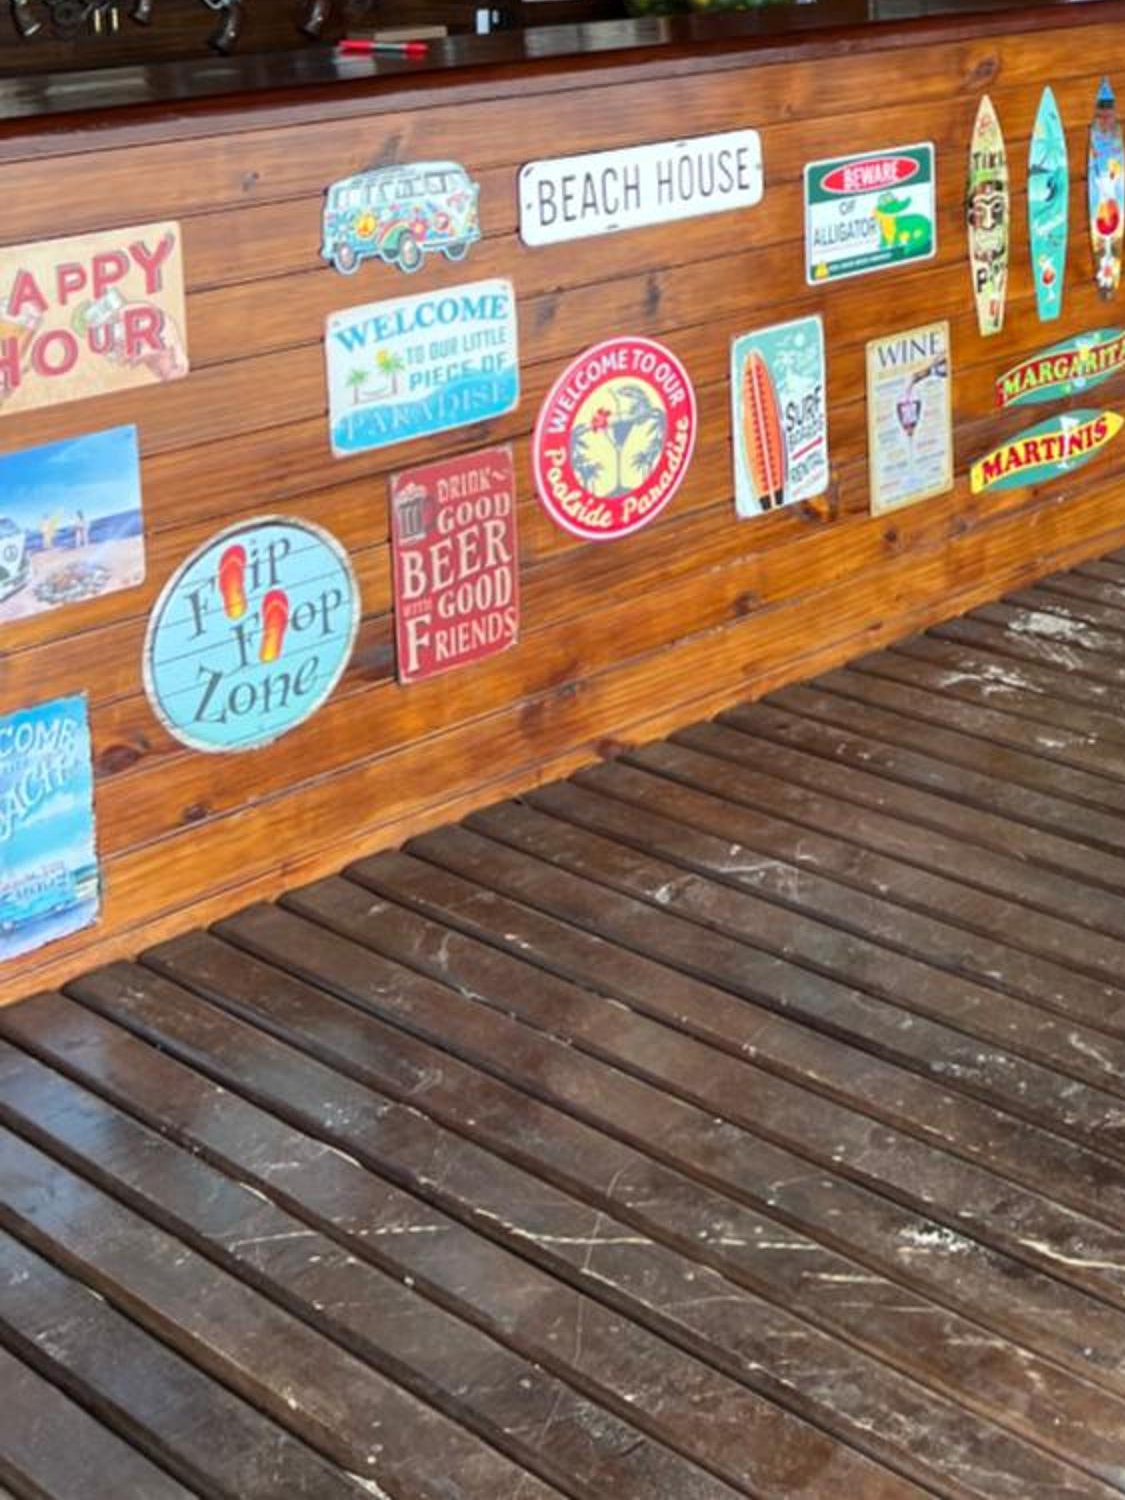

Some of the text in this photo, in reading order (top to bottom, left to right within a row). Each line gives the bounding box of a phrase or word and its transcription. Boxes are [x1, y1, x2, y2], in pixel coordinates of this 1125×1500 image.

[537, 146, 751, 227] BEACH HOUSE
[843, 160, 898, 192] BEWARE
[813, 216, 877, 248] ALLIGATOR
[7, 232, 176, 318] APPY
[335, 294, 509, 353] WELCOME
[462, 325, 508, 352] LITTLE
[877, 330, 941, 368] WINE
[408, 360, 472, 391] PIECE
[547, 348, 687, 435] WELCOME TO OUR
[543, 415, 689, 528] Poolside Paradise
[981, 417, 1110, 485] MARTINIS
[436, 467, 492, 504] DRINK
[436, 491, 512, 536] GOOD
[400, 519, 514, 600] BEER
[437, 566, 514, 619] GOOD
[404, 606, 519, 674] FRIENDS
[192, 655, 321, 724] Zone
[0, 717, 78, 757] COME
